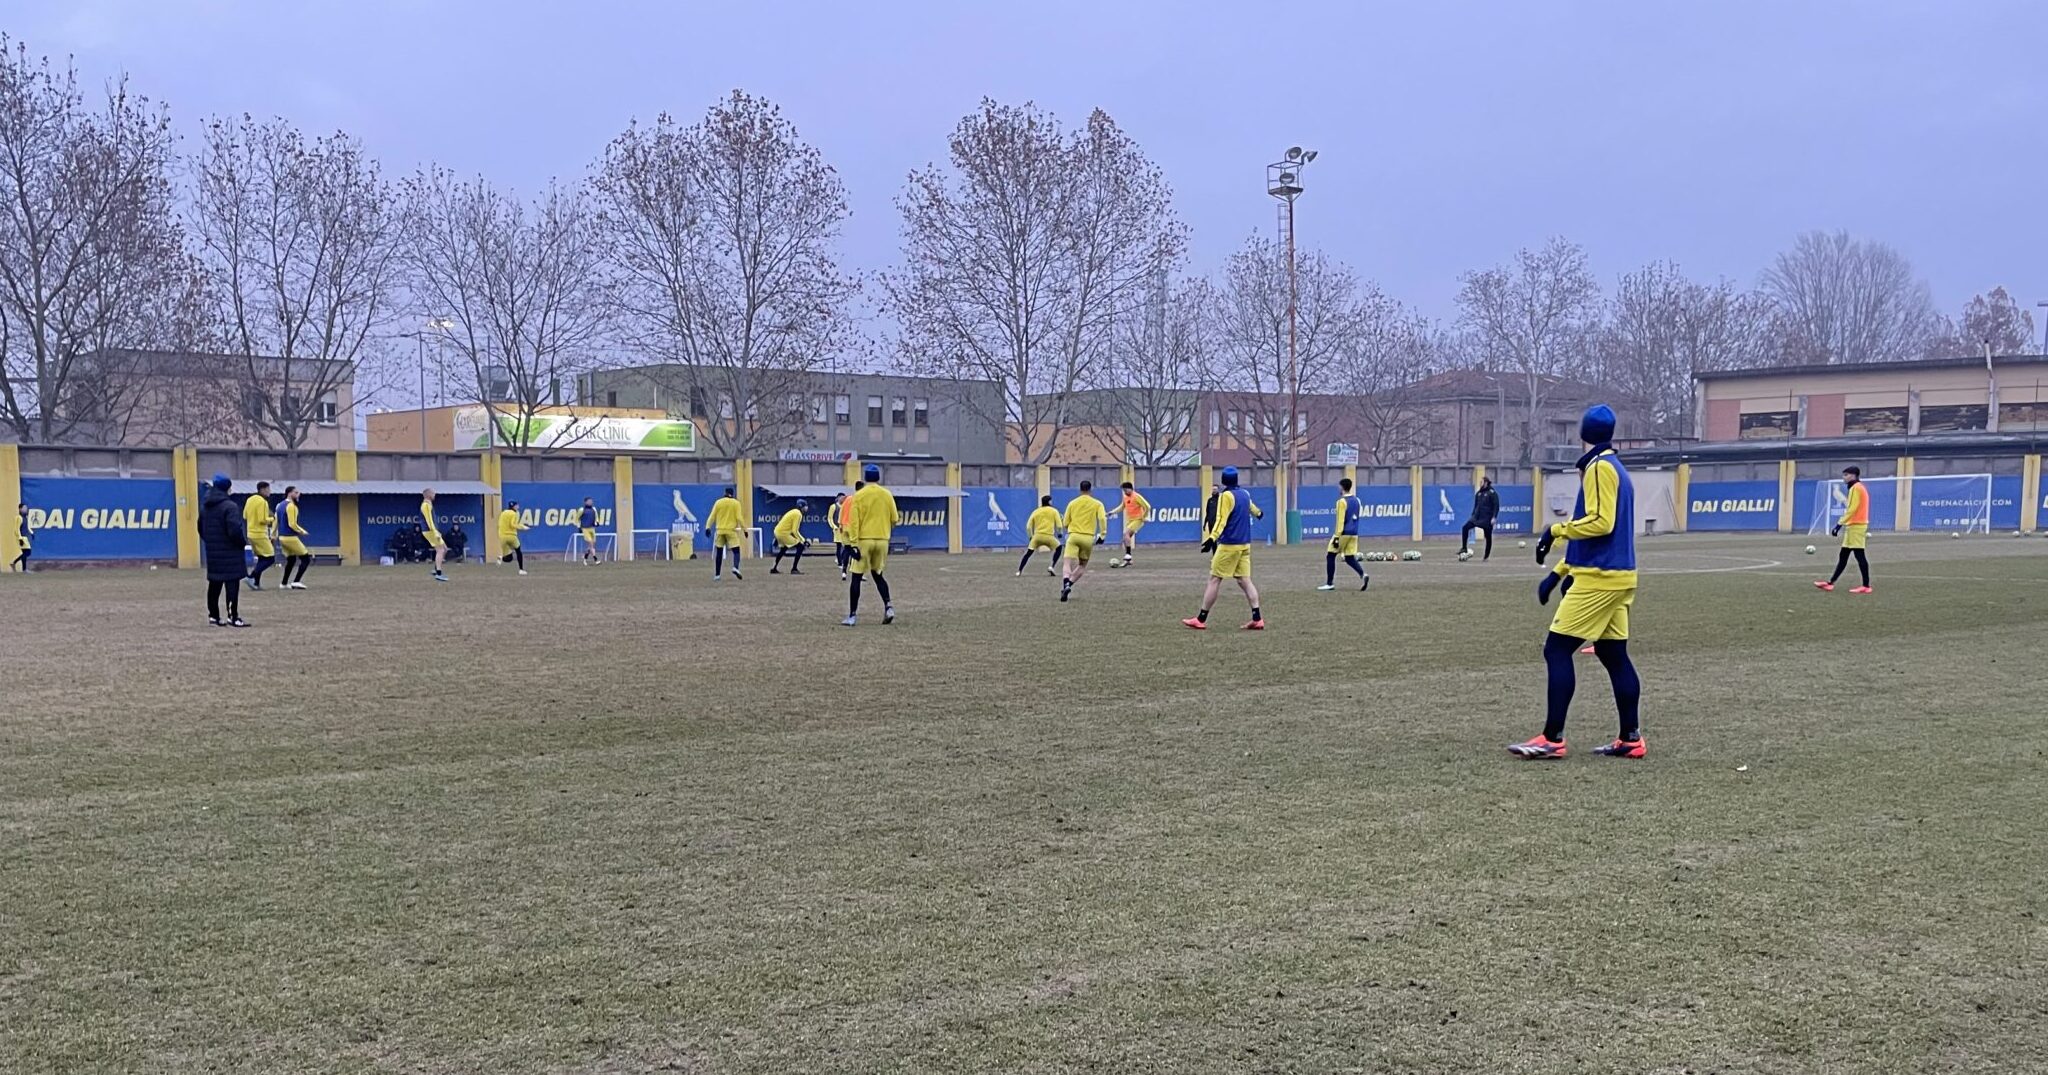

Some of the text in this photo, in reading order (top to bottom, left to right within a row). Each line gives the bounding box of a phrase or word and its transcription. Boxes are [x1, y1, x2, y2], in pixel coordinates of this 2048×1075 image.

[1691, 498, 1775, 513] DAI GIALLI!
[27, 508, 171, 530] DAI GIALLI!
[517, 508, 612, 527] AI GIAI!
